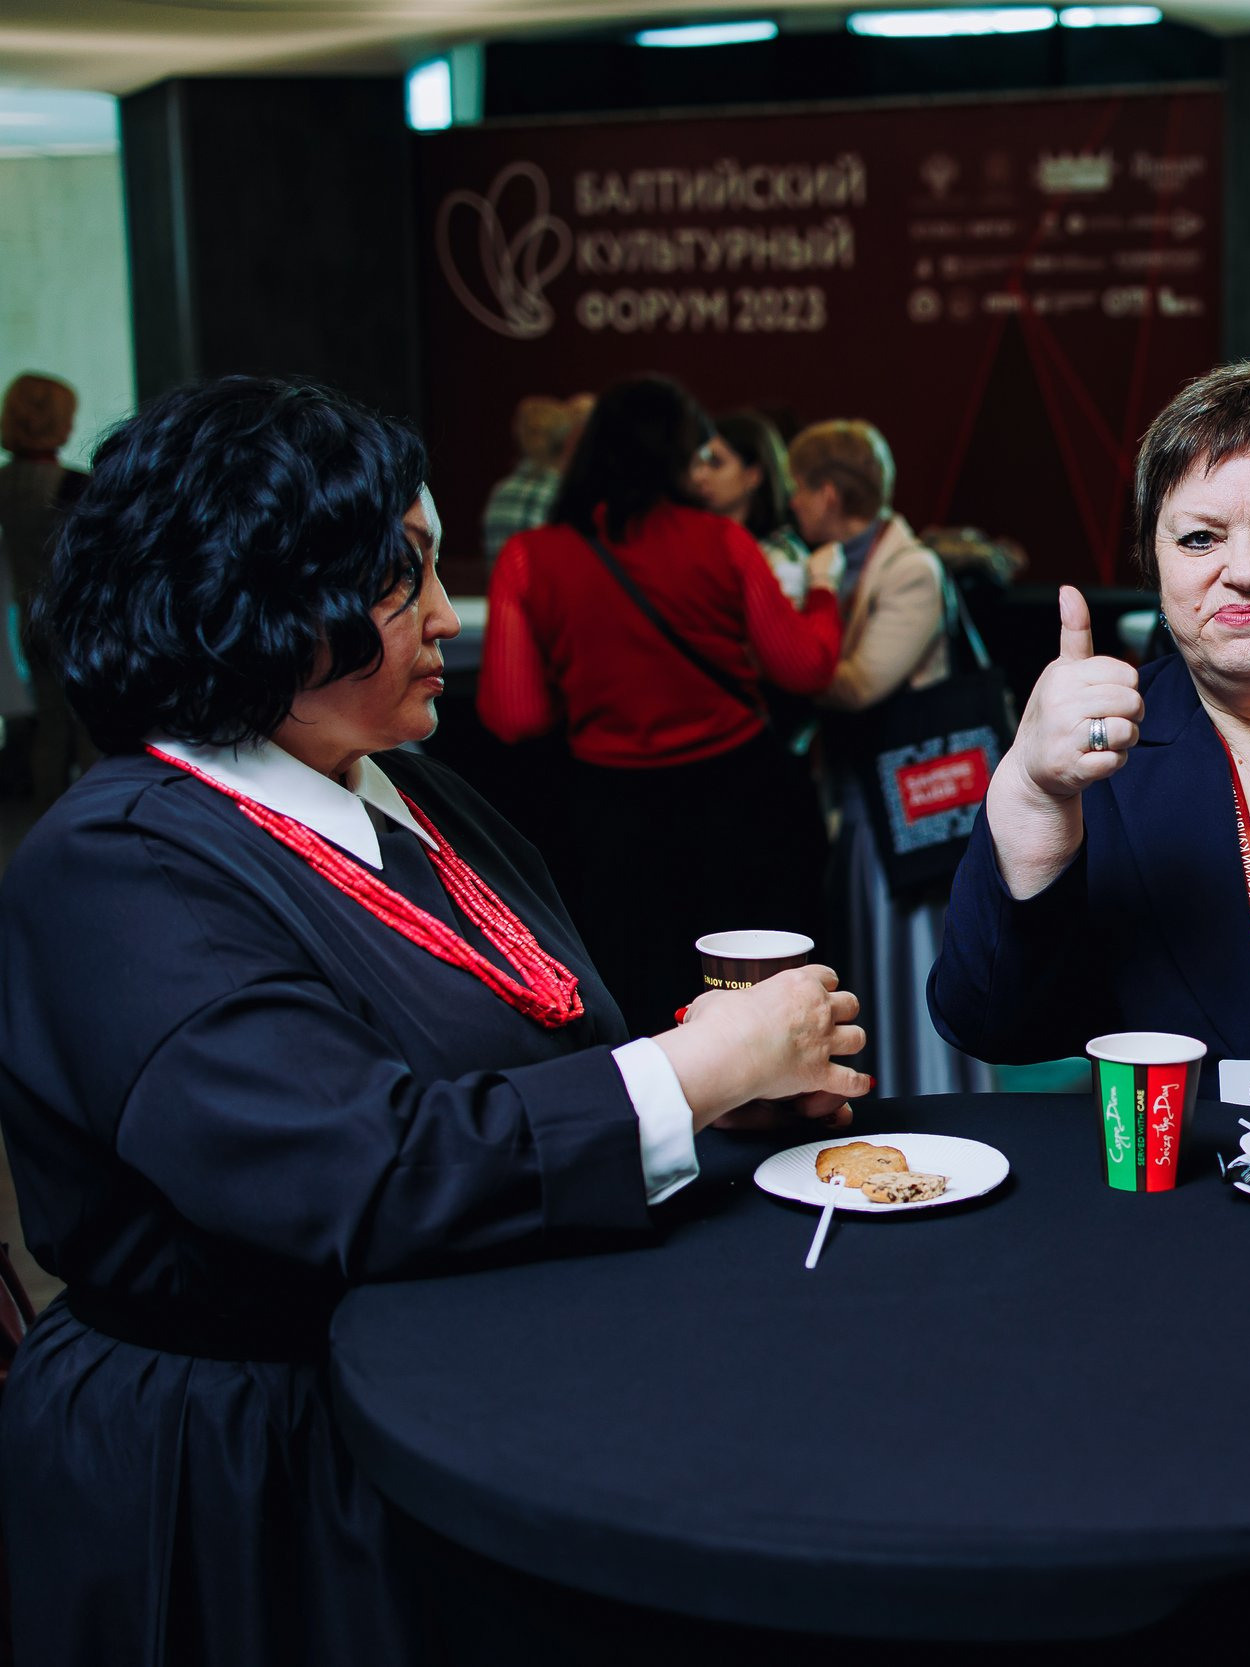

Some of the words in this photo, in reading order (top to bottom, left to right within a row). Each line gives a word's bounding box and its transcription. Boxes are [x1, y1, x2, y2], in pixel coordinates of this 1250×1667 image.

[575, 152, 866, 215] БАЛТИЙСКИЙ
[575, 215, 854, 274] КУЛЬТУРНЫЙ
[575, 287, 729, 334] ФОРУМ
[733, 285, 827, 333] 2023
[704, 974, 723, 987] ENJOY
[725, 980, 753, 990] YOUR
[1106, 1086, 1125, 1132] Diem
[1136, 1089, 1146, 1112] CARE
[1152, 1083, 1180, 1120] Day
[1136, 1113, 1146, 1135] WITH
[1136, 1136, 1146, 1166] SERVED
